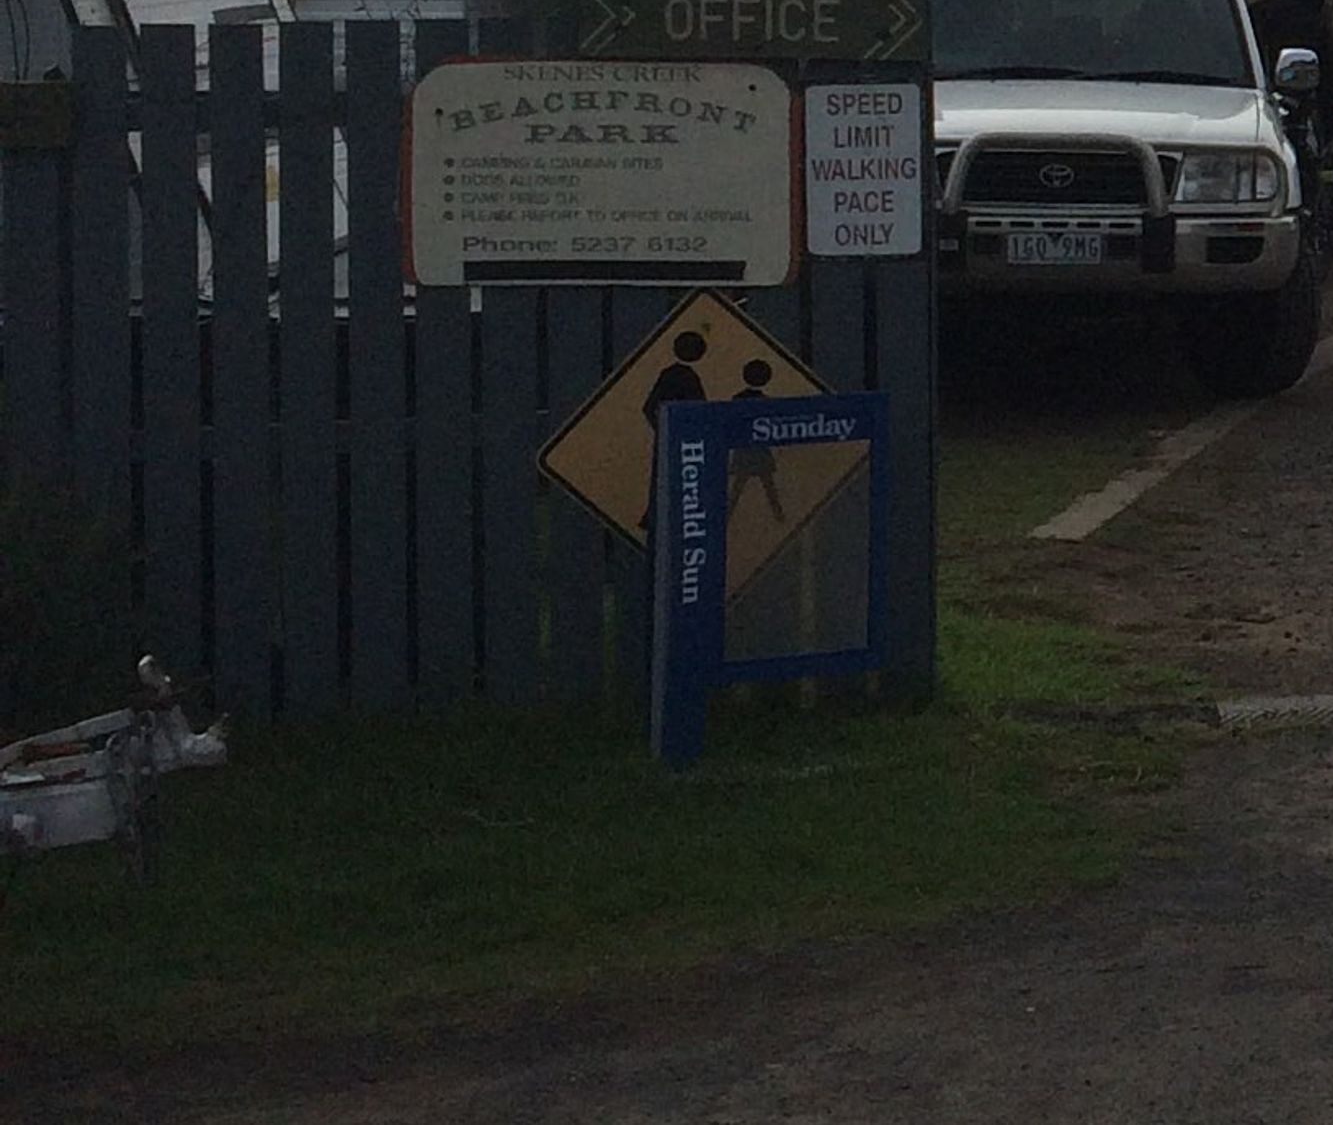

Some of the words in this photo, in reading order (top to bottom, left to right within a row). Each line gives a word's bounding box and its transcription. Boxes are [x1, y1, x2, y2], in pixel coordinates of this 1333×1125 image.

[612, 63, 700, 82] CREEK
[449, 89, 757, 134] BEACHFRONT
[826, 93, 903, 116] SPEED
[524, 124, 681, 144] PARK
[833, 126, 895, 148] LIMIT
[811, 157, 917, 181] WALKING
[833, 191, 895, 213] PACE
[462, 235, 559, 253] Phone:
[570, 236, 637, 253] 5237
[647, 236, 708, 253] 6132
[834, 224, 895, 247] ONLY
[752, 415, 857, 442] Sunday
[681, 439, 707, 539] Herald
[681, 543, 707, 605] Sun
